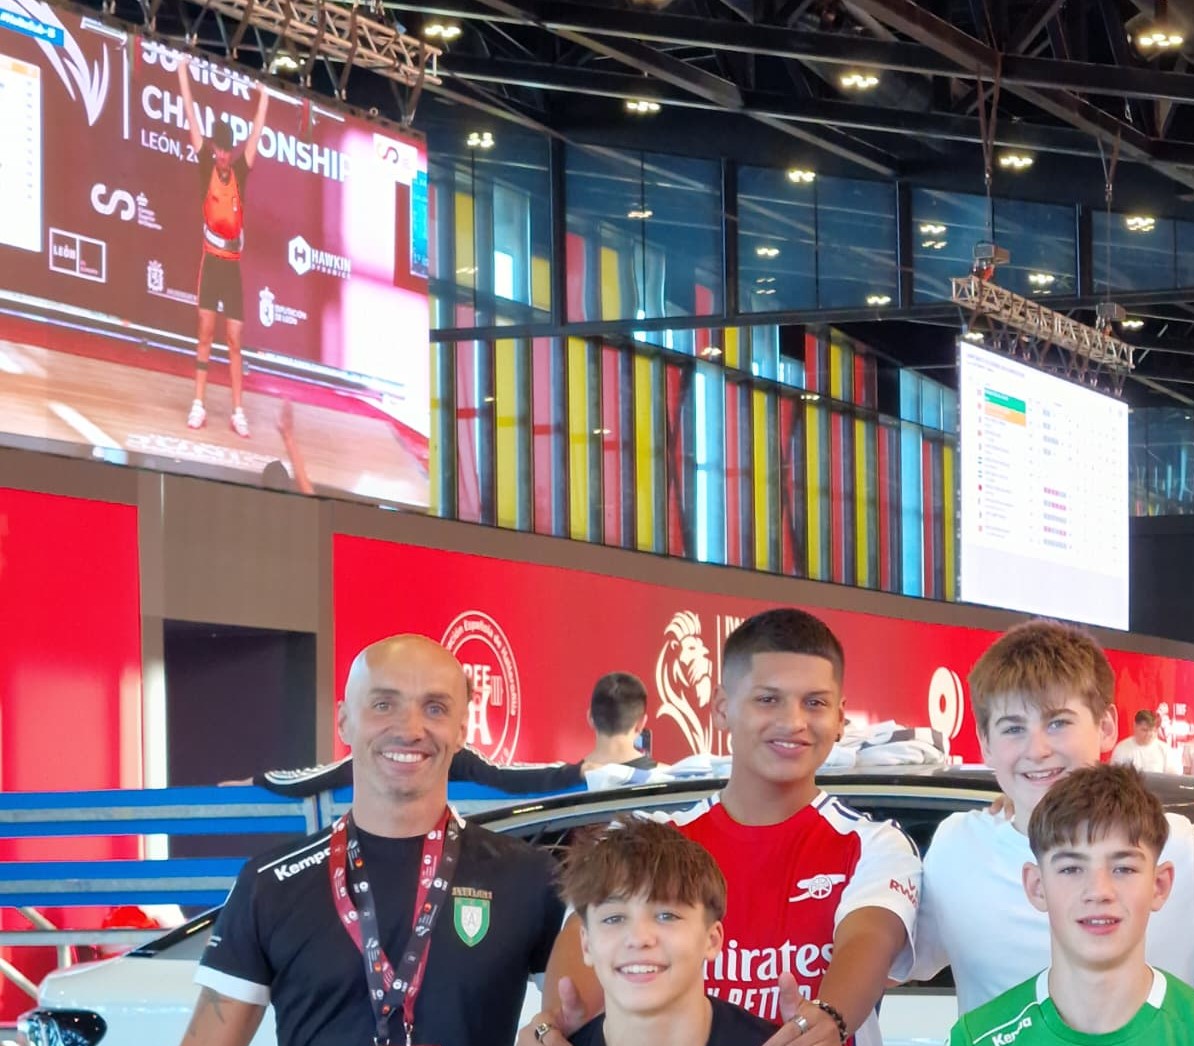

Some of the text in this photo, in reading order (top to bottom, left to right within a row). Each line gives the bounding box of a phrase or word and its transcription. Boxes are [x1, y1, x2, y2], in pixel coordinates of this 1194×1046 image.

[141, 85, 352, 183] CHAPONSHIP
[311, 248, 351, 274] HAWKIN
[704, 939, 835, 982] irates
[728, 985, 811, 1020] BETT
